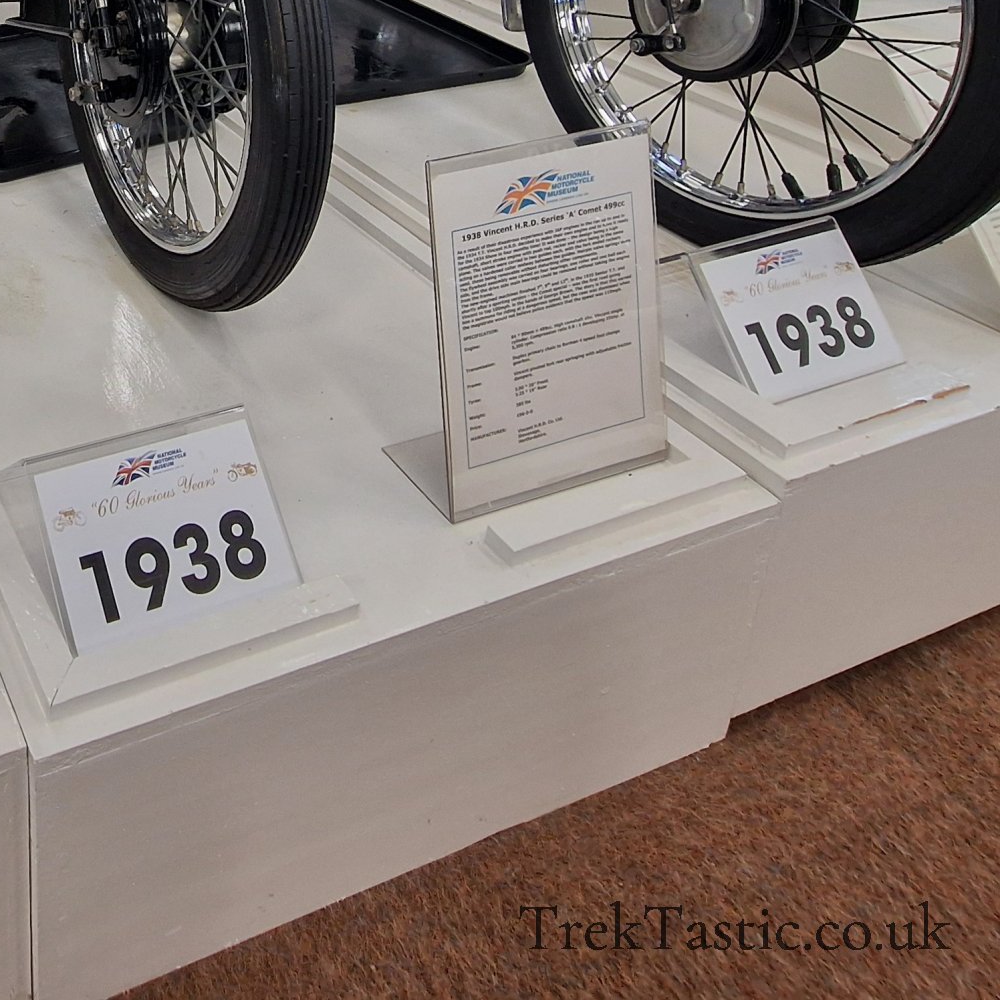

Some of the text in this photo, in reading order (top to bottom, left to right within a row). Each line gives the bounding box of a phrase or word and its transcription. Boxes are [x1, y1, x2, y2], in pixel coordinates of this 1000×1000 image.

[551, 175, 594, 189] MOTORCYCLE
[557, 170, 591, 181] NATIONAL
[547, 186, 578, 197] MUSEUM
[461, 231, 481, 242] 1938
[483, 225, 513, 237] Vincent
[514, 219, 539, 230] H.R.D.
[541, 214, 564, 225] Series
[578, 205, 602, 216] Comet
[603, 200, 625, 210] 499cc
[744, 296, 875, 375] 1938
[154, 452, 187, 465] MOTORCYCLE
[156, 448, 183, 459] NATIONAL
[152, 461, 175, 471] MUSEUM
[125, 488, 176, 511] Glorious
[79, 510, 267, 624] 1938
